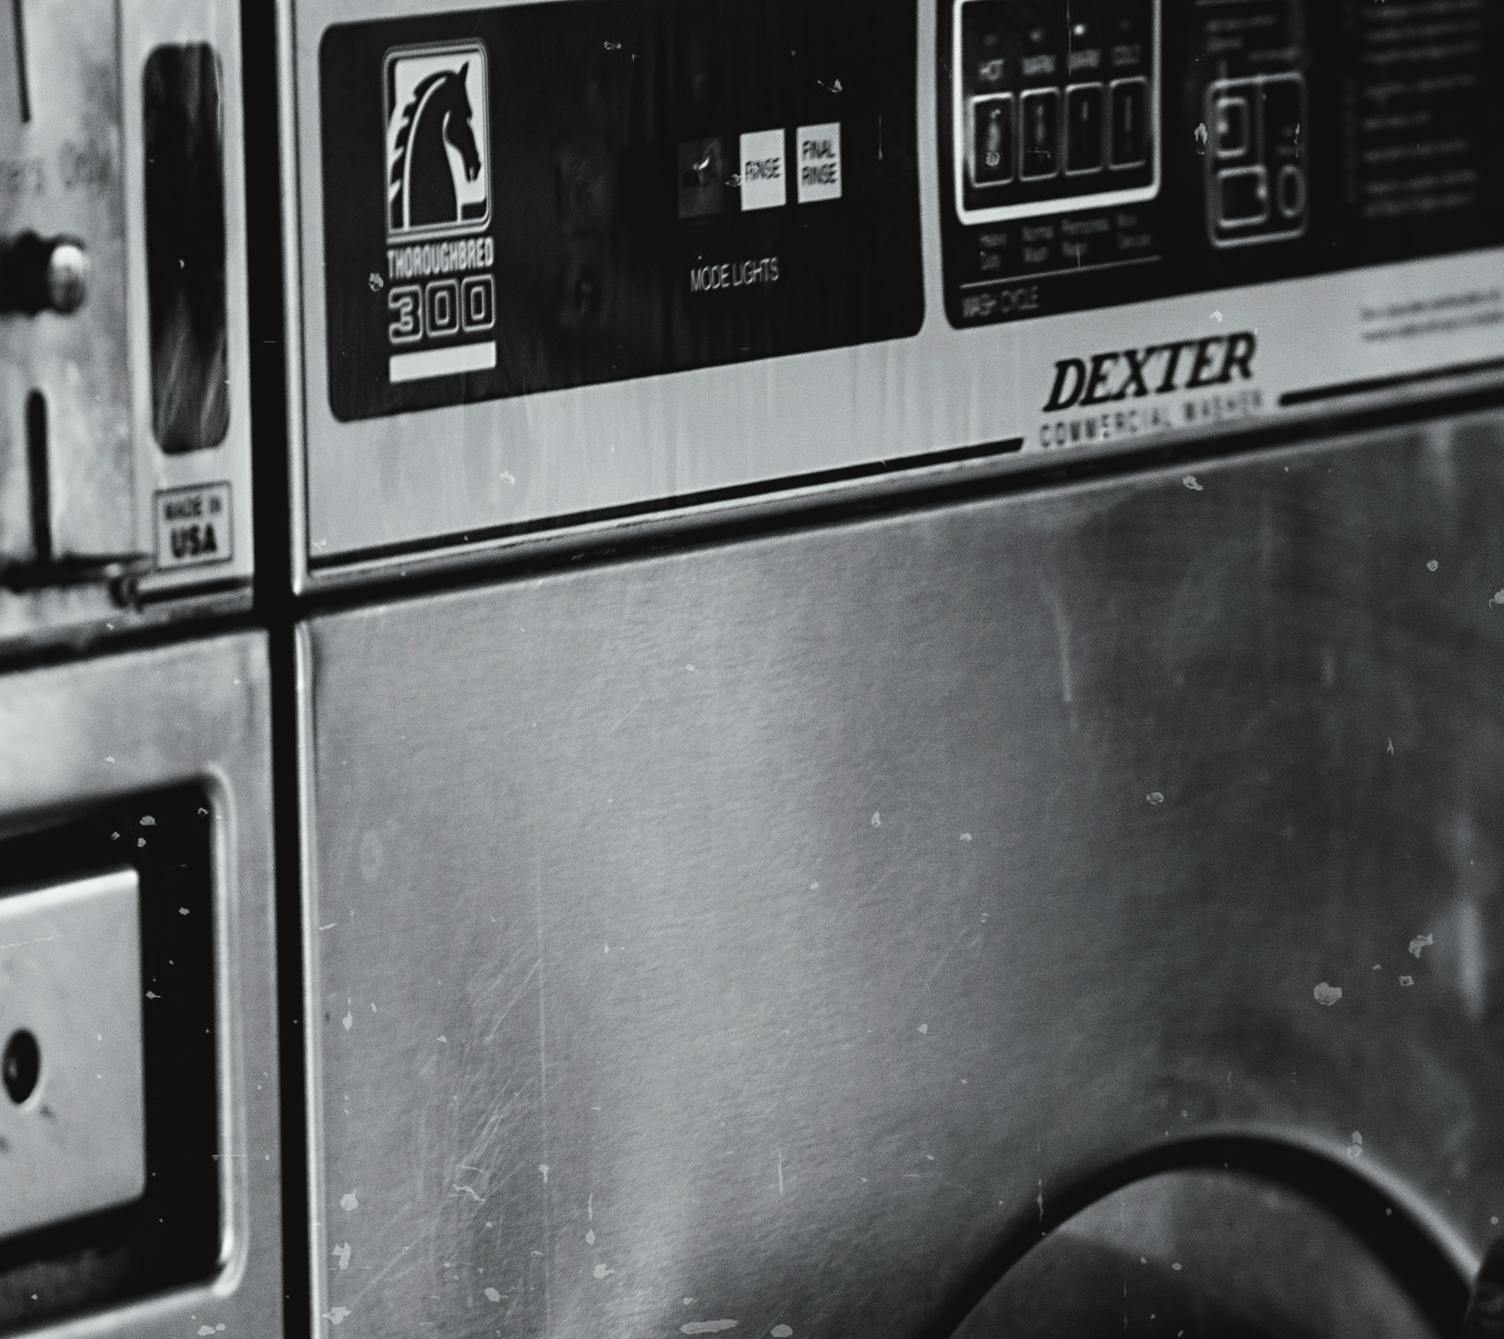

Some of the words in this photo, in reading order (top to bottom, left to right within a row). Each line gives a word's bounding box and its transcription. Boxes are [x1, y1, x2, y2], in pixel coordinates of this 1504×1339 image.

[802, 140, 836, 160] FINAL
[744, 158, 781, 181] RINSE
[801, 163, 837, 185] RINSE
[386, 237, 494, 280] THOROUGHBRED
[690, 263, 731, 292] MODE
[732, 256, 780, 287] LIGHTS
[387, 274, 496, 344] 300
[1042, 330, 1257, 413] DEXTER
[165, 497, 202, 521] MADE
[170, 523, 217, 558] USA
